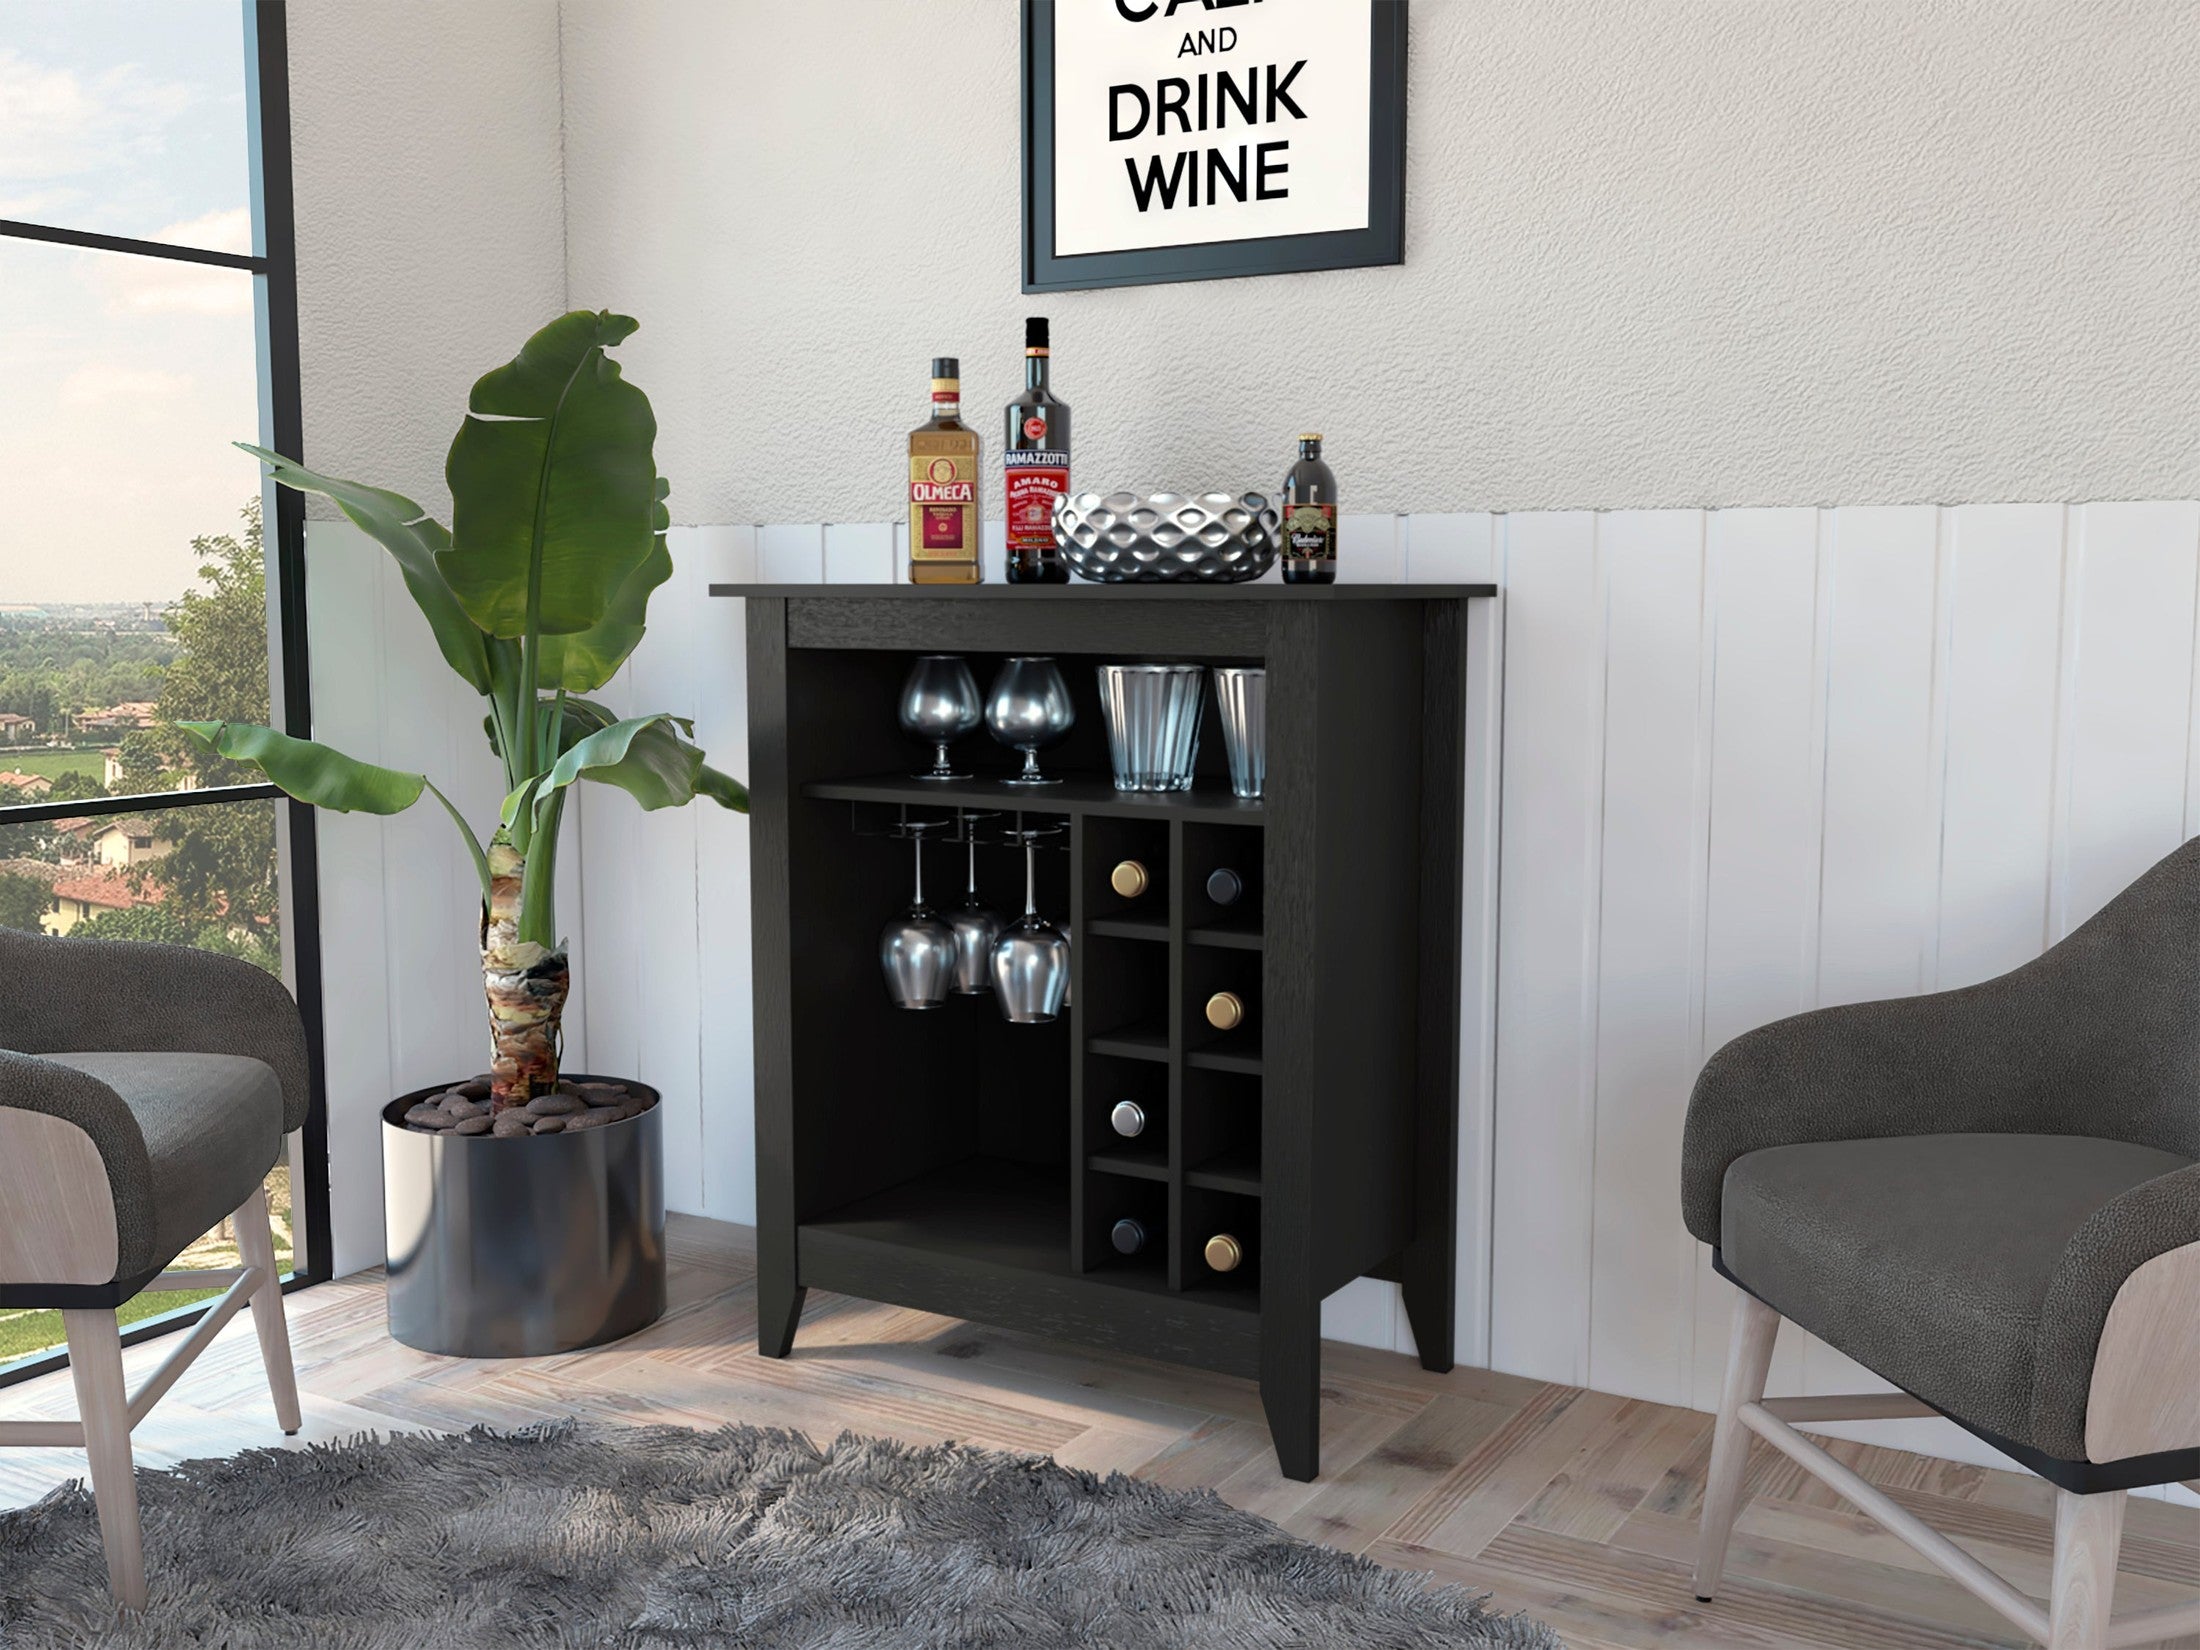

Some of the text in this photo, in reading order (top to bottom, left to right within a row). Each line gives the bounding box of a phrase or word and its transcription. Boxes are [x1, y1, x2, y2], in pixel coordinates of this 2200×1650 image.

[1178, 26, 1238, 58] AND
[1109, 60, 1308, 141] DRINK
[1125, 141, 1289, 212] WINE
[1005, 452, 1068, 465] RAMAZZOTTI
[913, 483, 972, 501] OLMECA
[1014, 476, 1058, 489] AMARO
